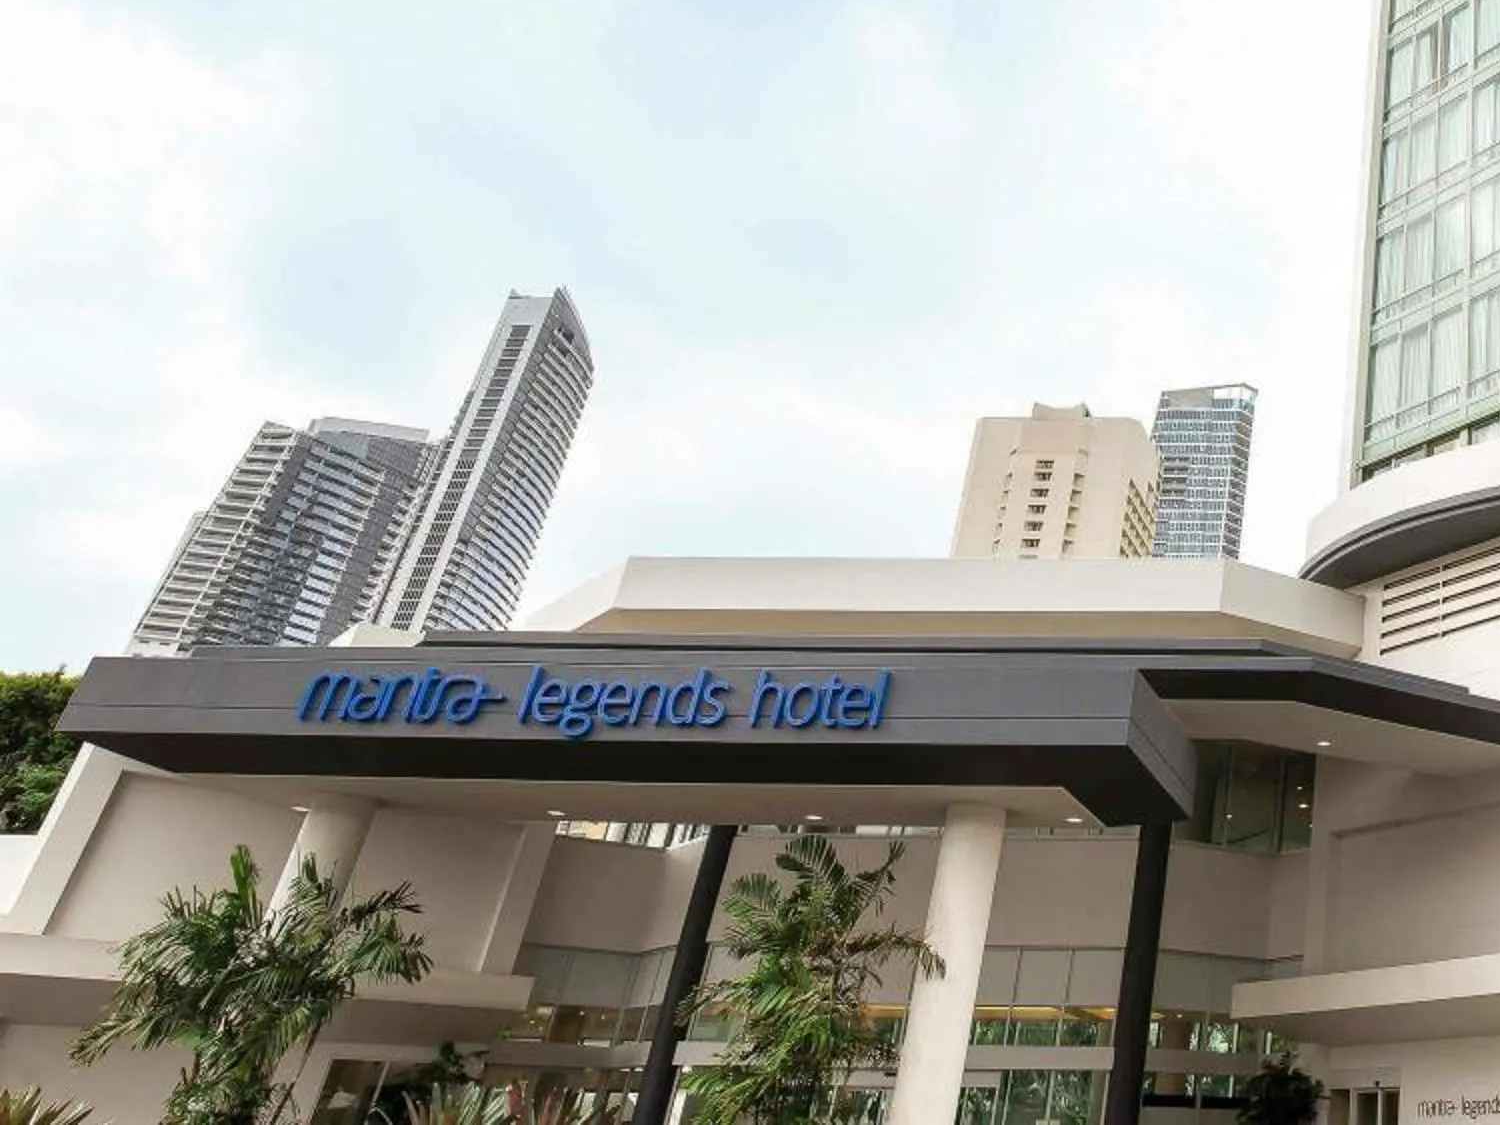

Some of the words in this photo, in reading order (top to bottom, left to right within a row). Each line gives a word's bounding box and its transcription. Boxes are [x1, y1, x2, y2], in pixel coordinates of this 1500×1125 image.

[296, 666, 504, 725] mantra
[516, 665, 731, 738] legends
[747, 668, 892, 729] hotel
